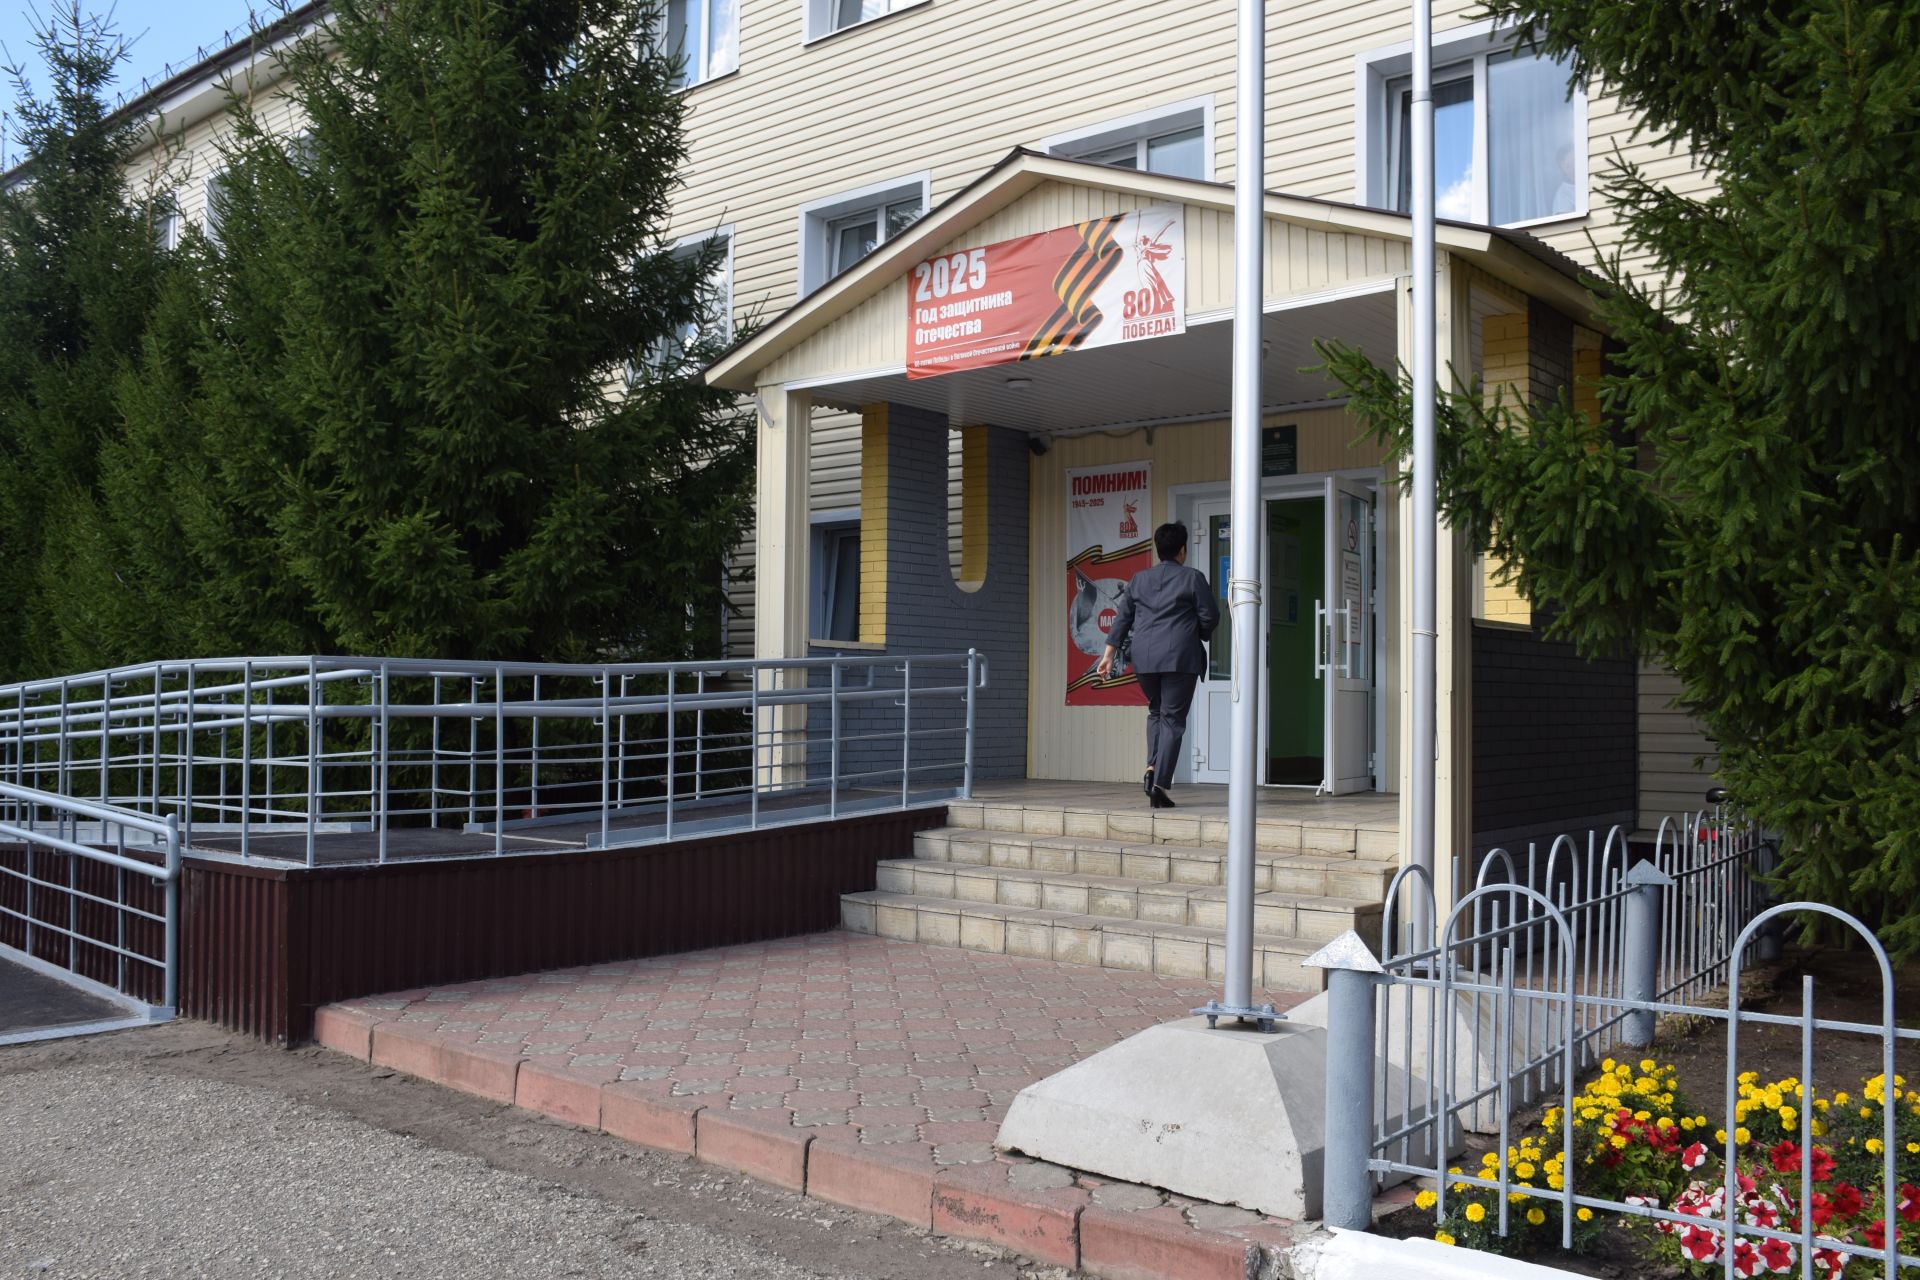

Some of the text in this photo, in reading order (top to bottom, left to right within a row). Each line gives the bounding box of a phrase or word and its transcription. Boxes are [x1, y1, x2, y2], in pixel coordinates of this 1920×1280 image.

[915, 248, 986, 303] 2025
[915, 290, 1013, 325] Год защитника
[1123, 287, 1151, 320] 80
[915, 318, 982, 346] Отечества
[1122, 317, 1176, 340] ПОБЕДА!
[1072, 469, 1147, 496] ПОМНИМ!
